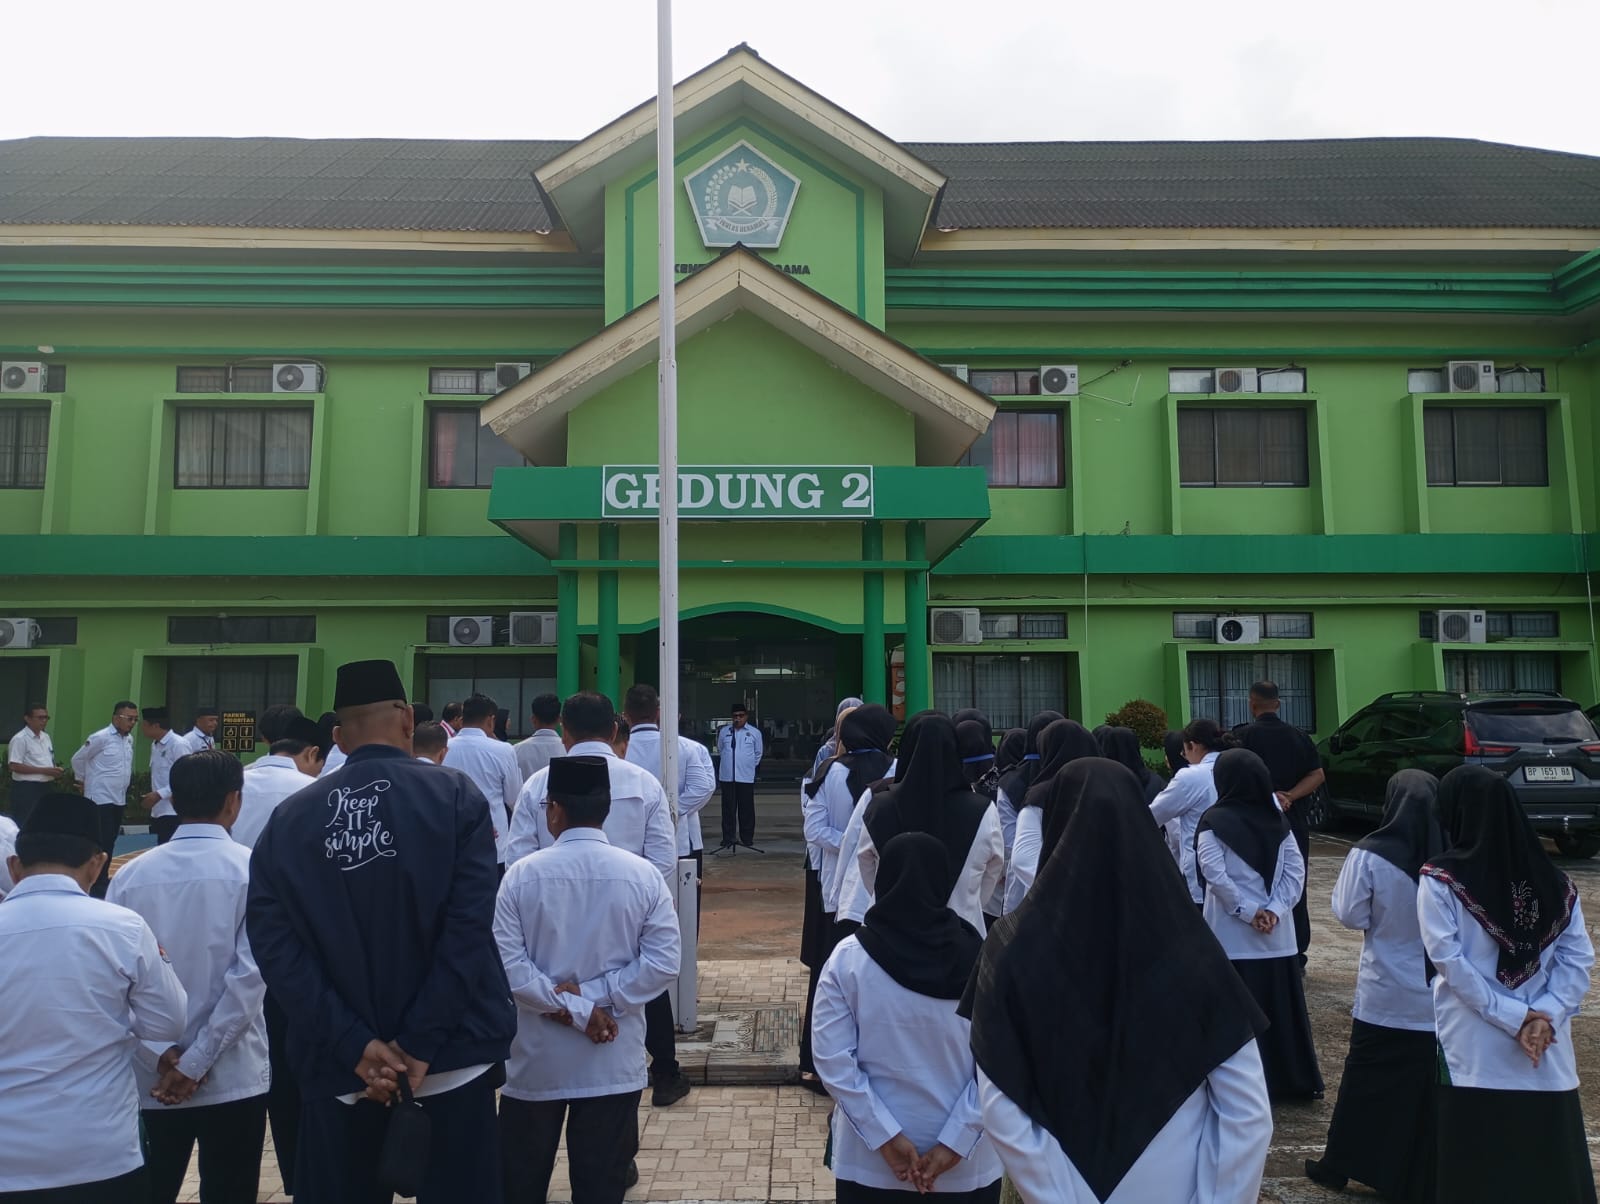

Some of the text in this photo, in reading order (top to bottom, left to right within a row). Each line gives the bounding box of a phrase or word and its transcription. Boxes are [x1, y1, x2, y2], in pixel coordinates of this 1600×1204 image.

[841, 472, 871, 508] 2
[1541, 767, 1558, 776] 1651
[325, 786, 381, 827] Keep
[325, 822, 395, 860] simple
